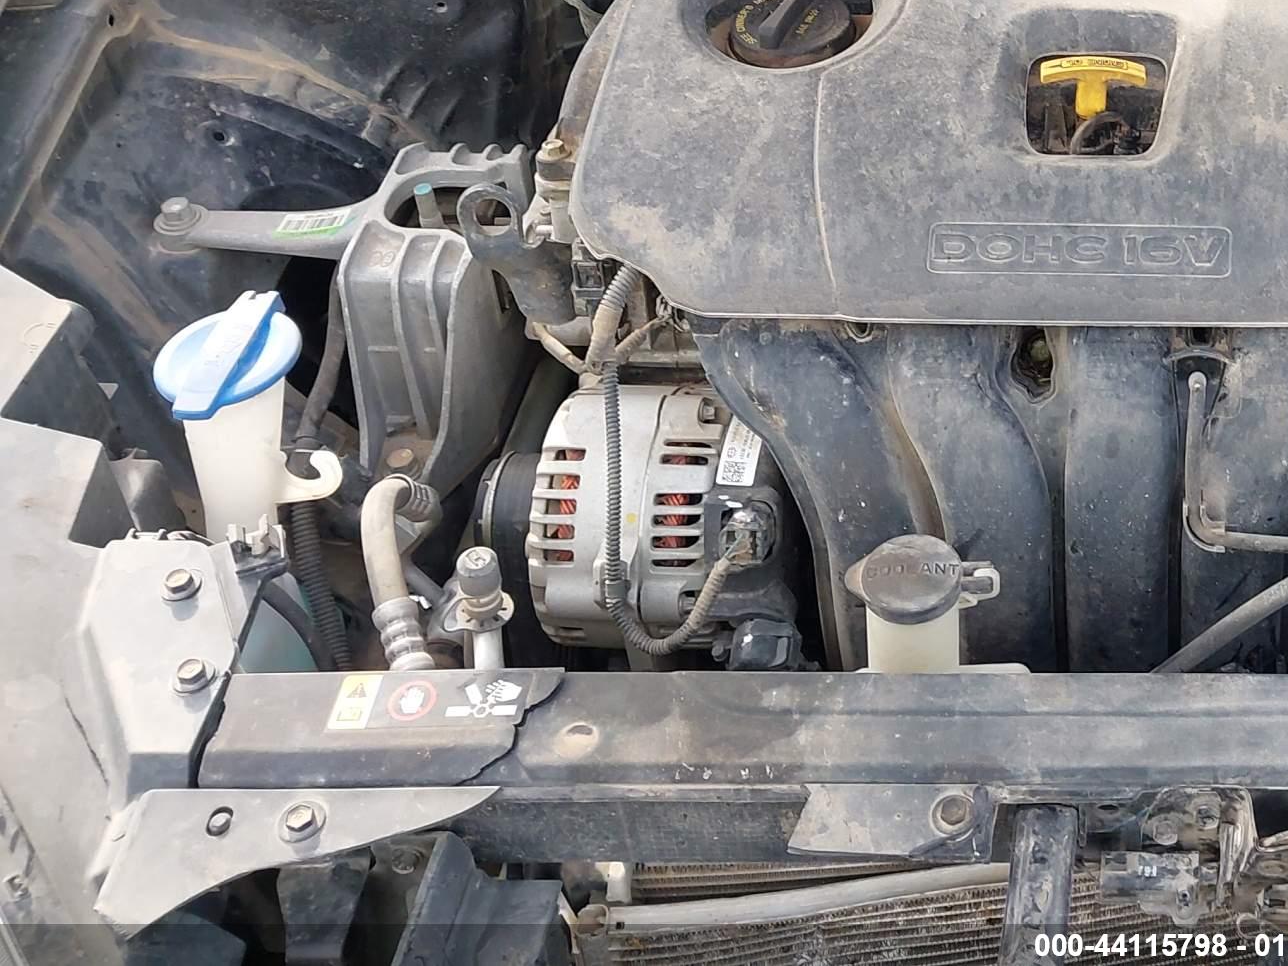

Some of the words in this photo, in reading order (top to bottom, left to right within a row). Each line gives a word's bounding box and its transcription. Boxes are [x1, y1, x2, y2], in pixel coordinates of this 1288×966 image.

[931, 231, 1108, 265] DOHC
[1122, 234, 1226, 267] 16V
[865, 561, 960, 579] COOLANT
